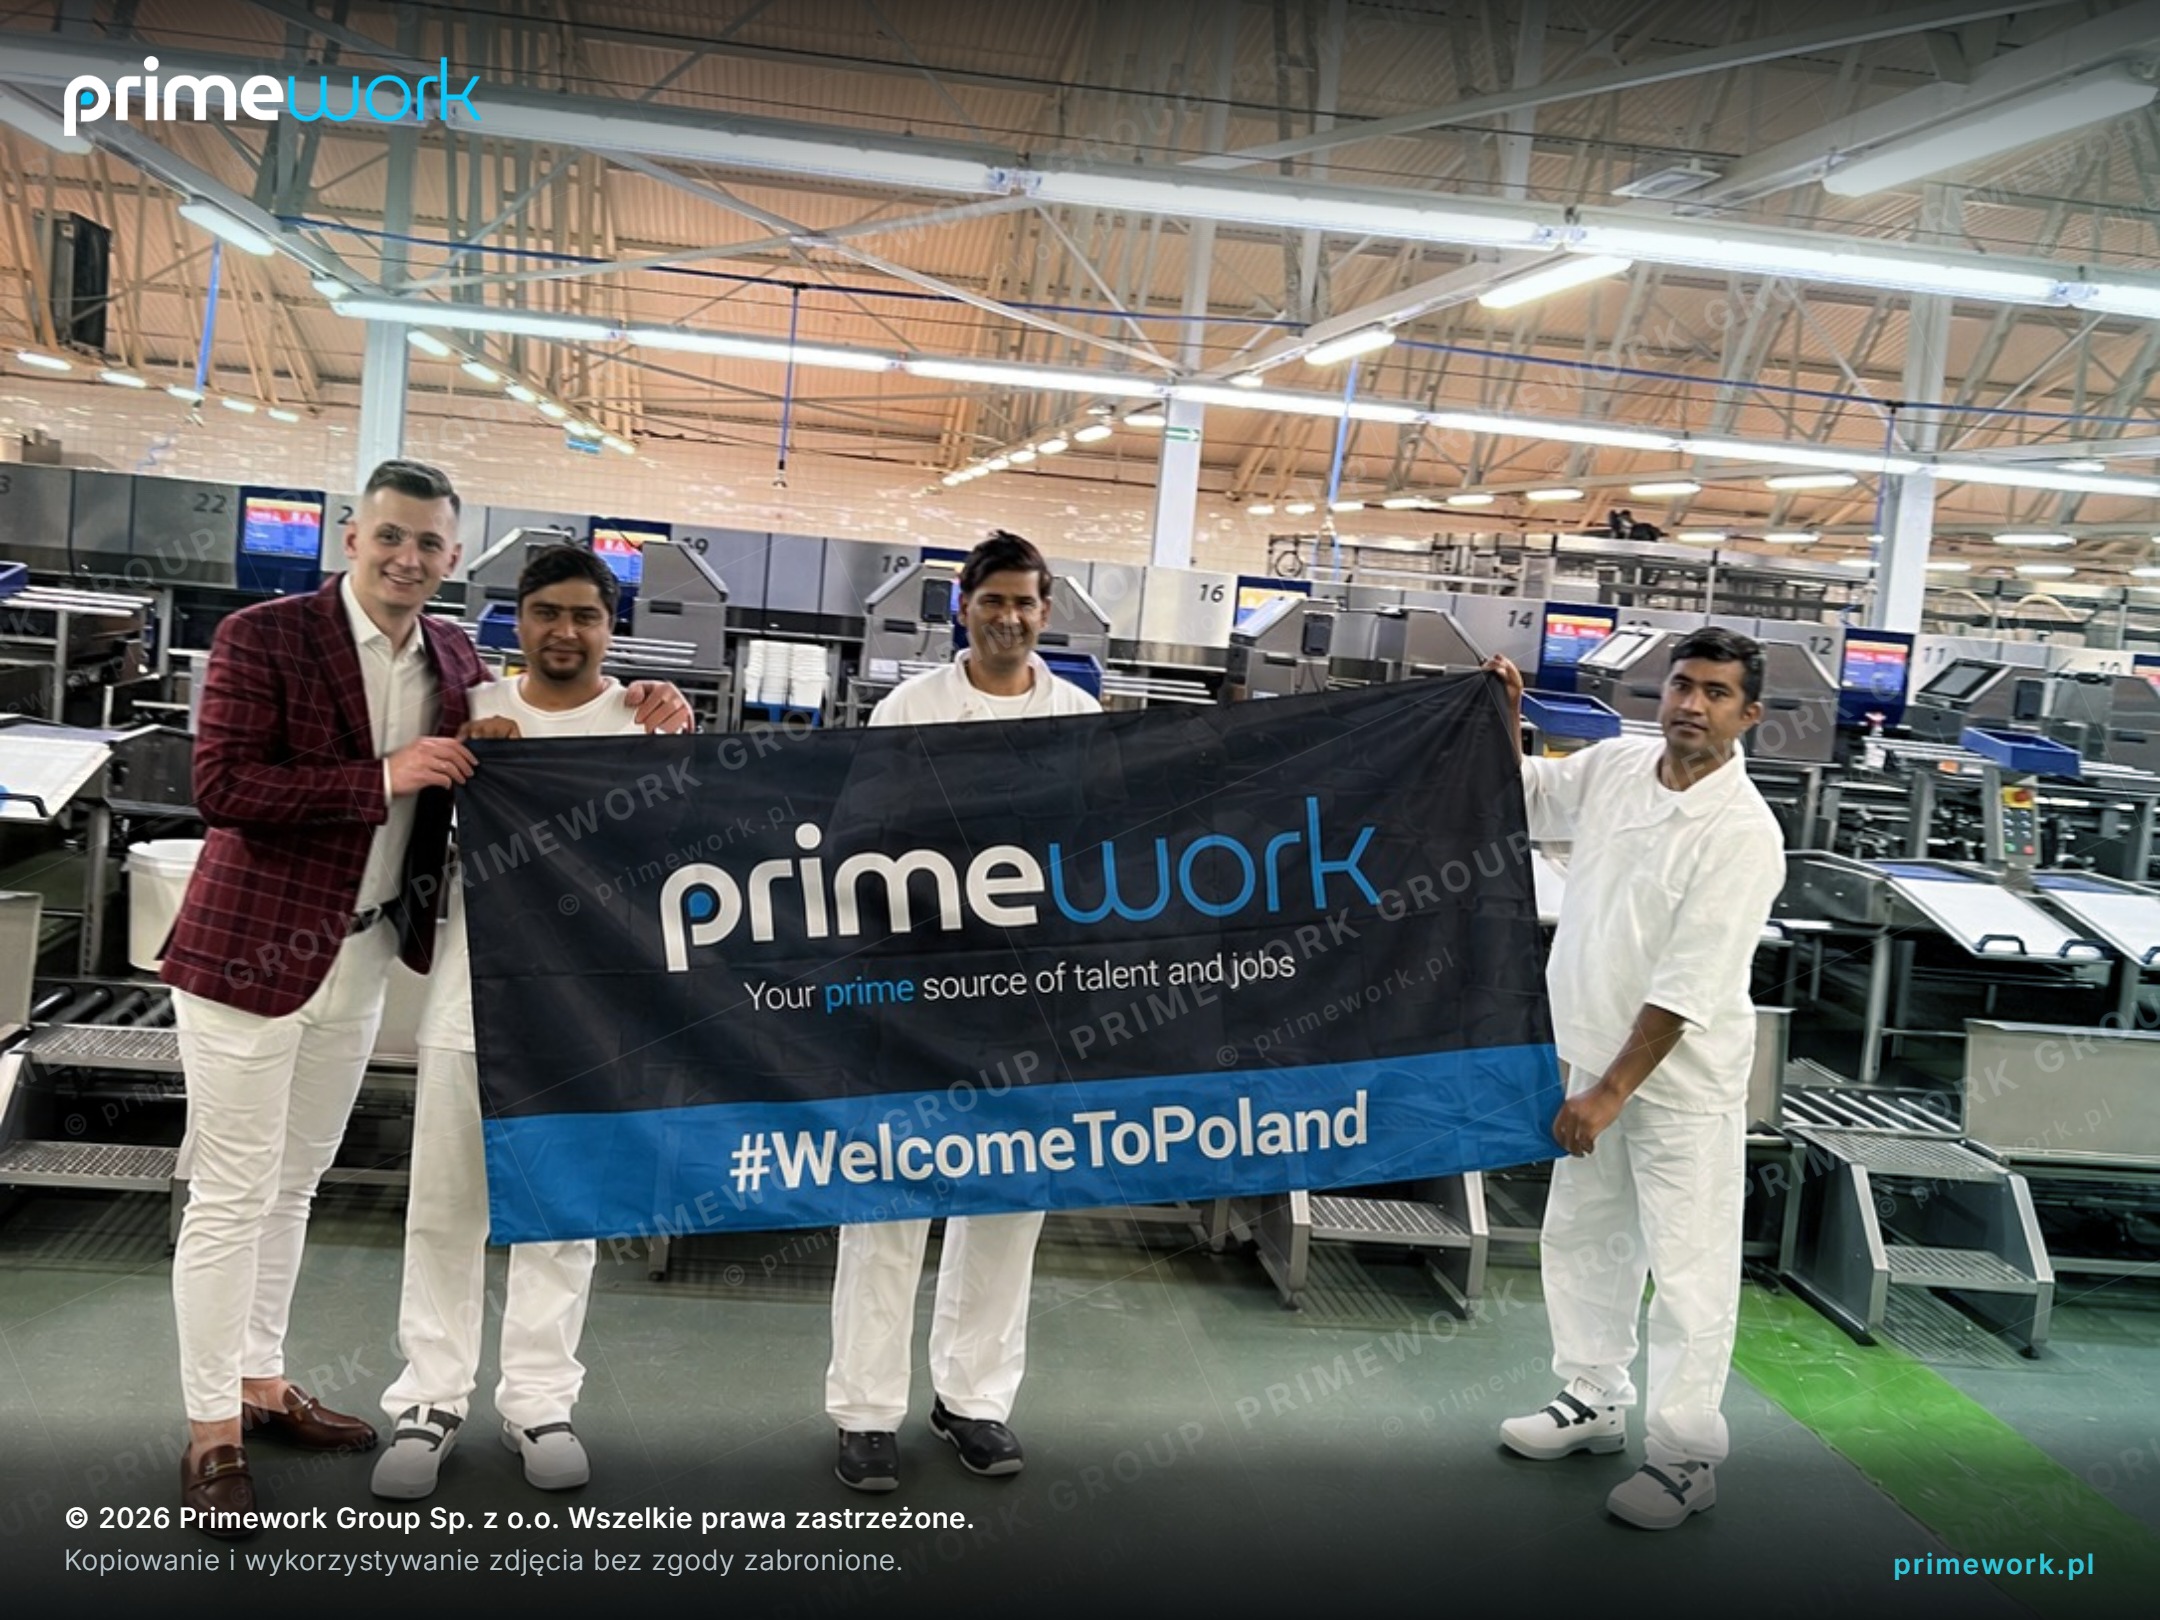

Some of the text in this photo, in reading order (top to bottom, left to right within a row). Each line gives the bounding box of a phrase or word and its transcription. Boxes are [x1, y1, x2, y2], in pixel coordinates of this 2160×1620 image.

[193, 493, 227, 514] 22
[882, 554, 911, 574] 18
[1200, 584, 1224, 603] 16
[1508, 610, 1533, 629] 14
[1809, 636, 1834, 655] 12
[1924, 646, 1946, 665] 11
[660, 797, 1383, 973] primework
[744, 951, 1296, 1013] Your prime source of talent and jobs
[731, 1090, 1367, 1193] #WelcomeToPoland
